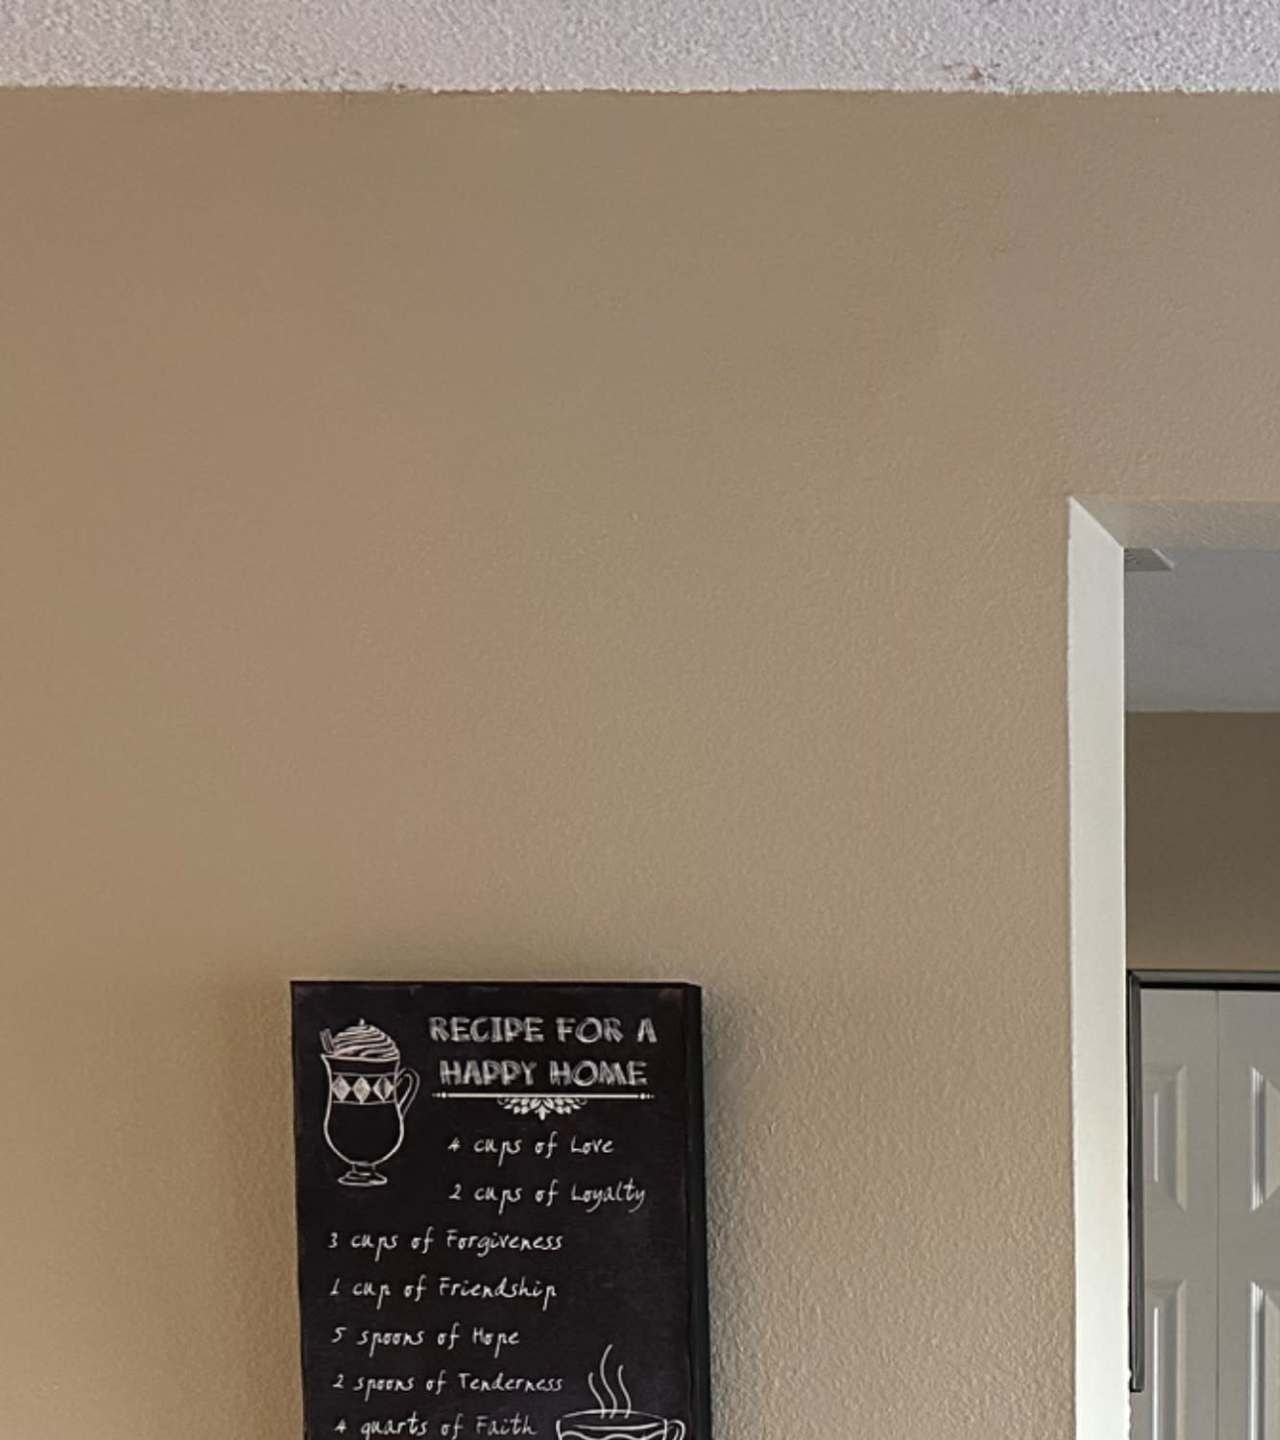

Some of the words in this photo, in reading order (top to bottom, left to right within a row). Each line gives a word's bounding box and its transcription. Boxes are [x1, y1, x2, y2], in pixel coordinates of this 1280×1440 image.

[429, 1017, 544, 1042] RECIPE
[556, 1017, 624, 1043] FOR
[637, 1017, 657, 1043] A
[440, 1061, 538, 1086] HAPPY
[550, 1061, 648, 1086] HOME
[448, 1137, 460, 1152] 4
[474, 1138, 522, 1167] cups
[535, 1132, 558, 1158] of
[572, 1137, 614, 1154] Love
[448, 1184, 462, 1200] 2
[475, 1187, 522, 1215] cups
[535, 1180, 558, 1206] of
[572, 1178, 645, 1213] Loyalty
[327, 1233, 338, 1248] 3
[351, 1234, 398, 1261] cups
[411, 1227, 433, 1254] of
[446, 1233, 563, 1256] Forgiveness
[330, 1278, 339, 1295] 1
[352, 1283, 391, 1310] cup
[404, 1274, 426, 1301] of
[439, 1278, 557, 1311] Friendship
[331, 1327, 345, 1343] 5
[356, 1328, 424, 1357] spoons
[437, 1323, 459, 1350] of
[473, 1327, 520, 1357] Hope
[332, 1374, 344, 1388] 2
[354, 1376, 414, 1401] spoons
[426, 1370, 447, 1395] of
[459, 1372, 563, 1391] Tenderness
[335, 1418, 347, 1434] 4
[441, 1414, 464, 1440] of
[476, 1415, 537, 1436] Faith
